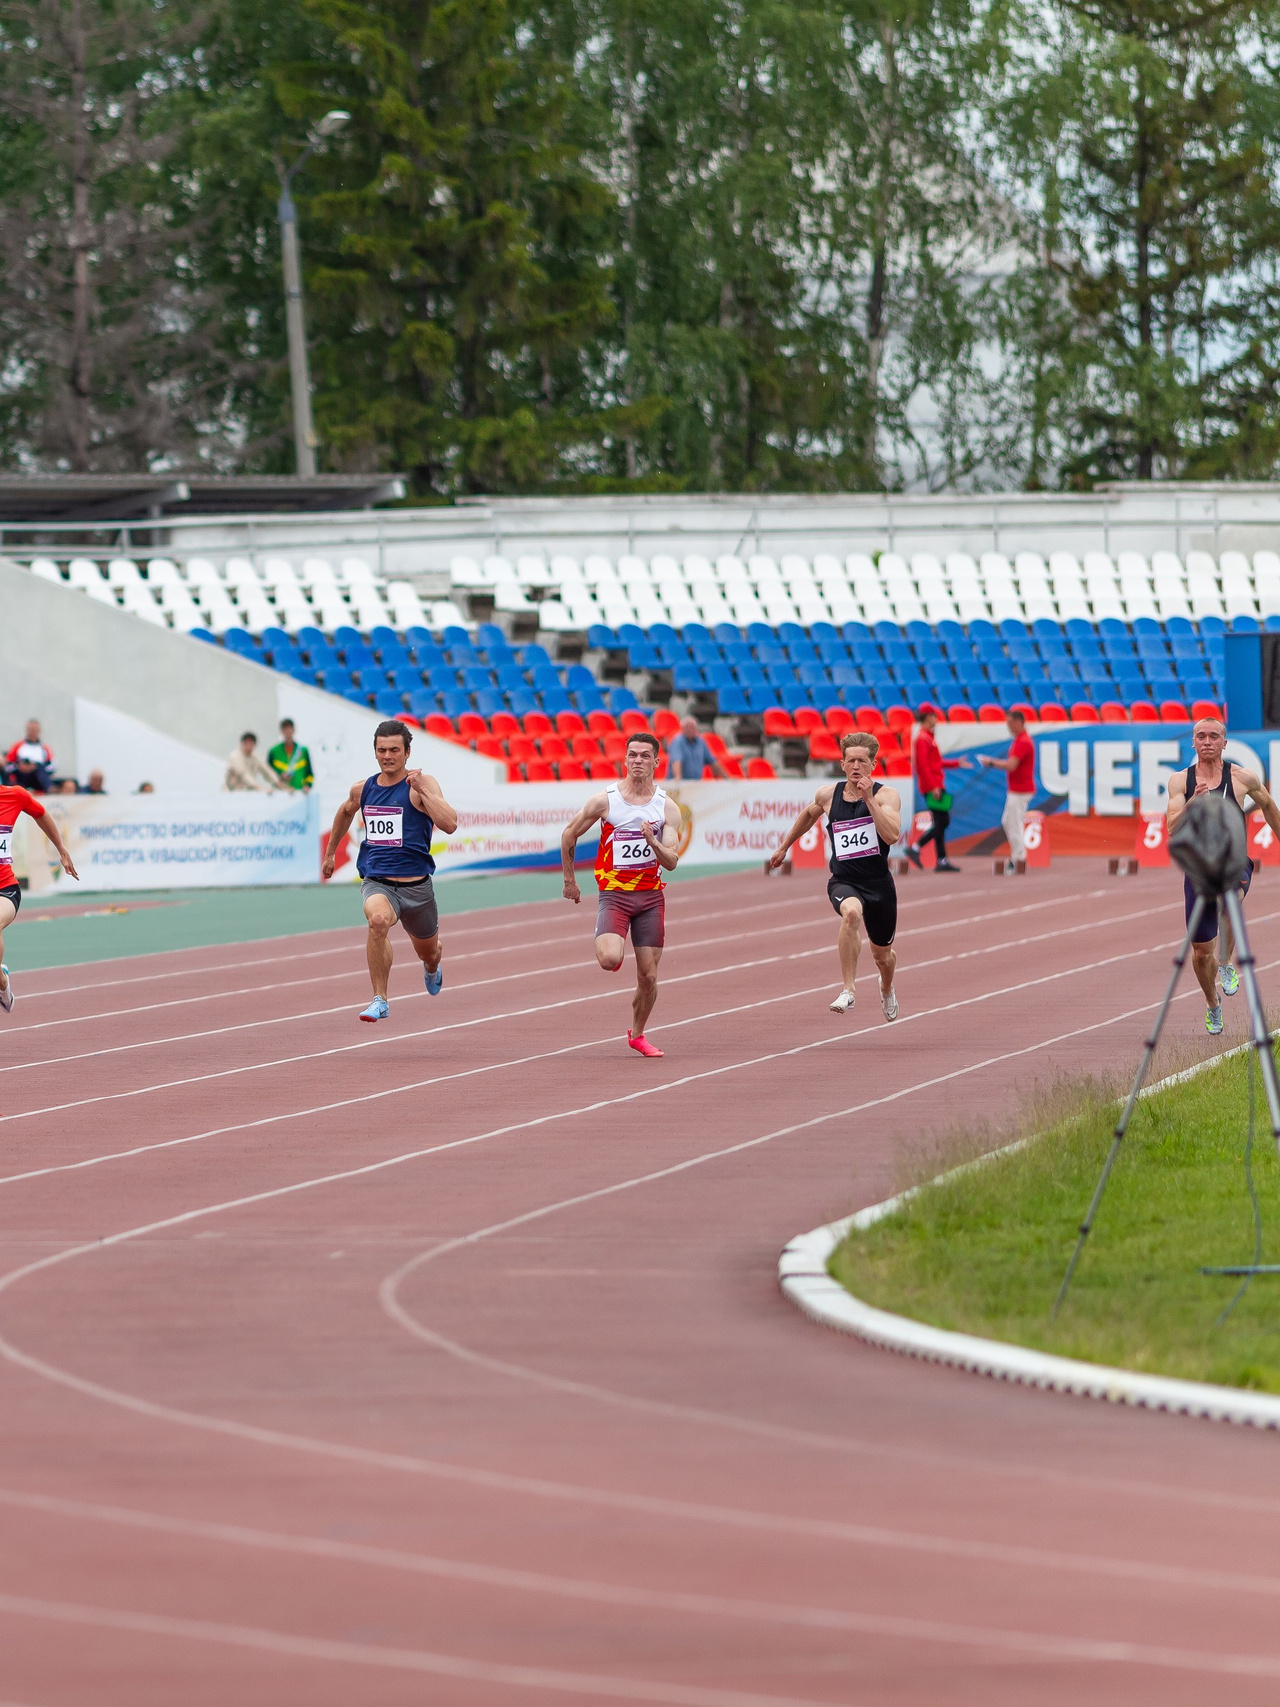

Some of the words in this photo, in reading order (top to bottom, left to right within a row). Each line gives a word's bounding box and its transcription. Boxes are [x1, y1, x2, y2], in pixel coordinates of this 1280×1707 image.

[80, 823, 168, 839] МИНИСТЕРСТВО
[171, 819, 245, 838] ФИЗИЧЕСКОЙ
[248, 820, 307, 836] КУЛЬТУРЫ
[369, 820, 394, 834] 108
[1023, 823, 1042, 850] 6
[1143, 822, 1163, 849] 5
[1253, 822, 1274, 849] 4
[841, 831, 869, 848] 346
[101, 849, 145, 865] СПОРТА
[149, 845, 217, 863] ЧУВАШСКОЙ
[221, 845, 294, 862] РЕСПУБЛИКИ
[622, 844, 651, 858] 266
